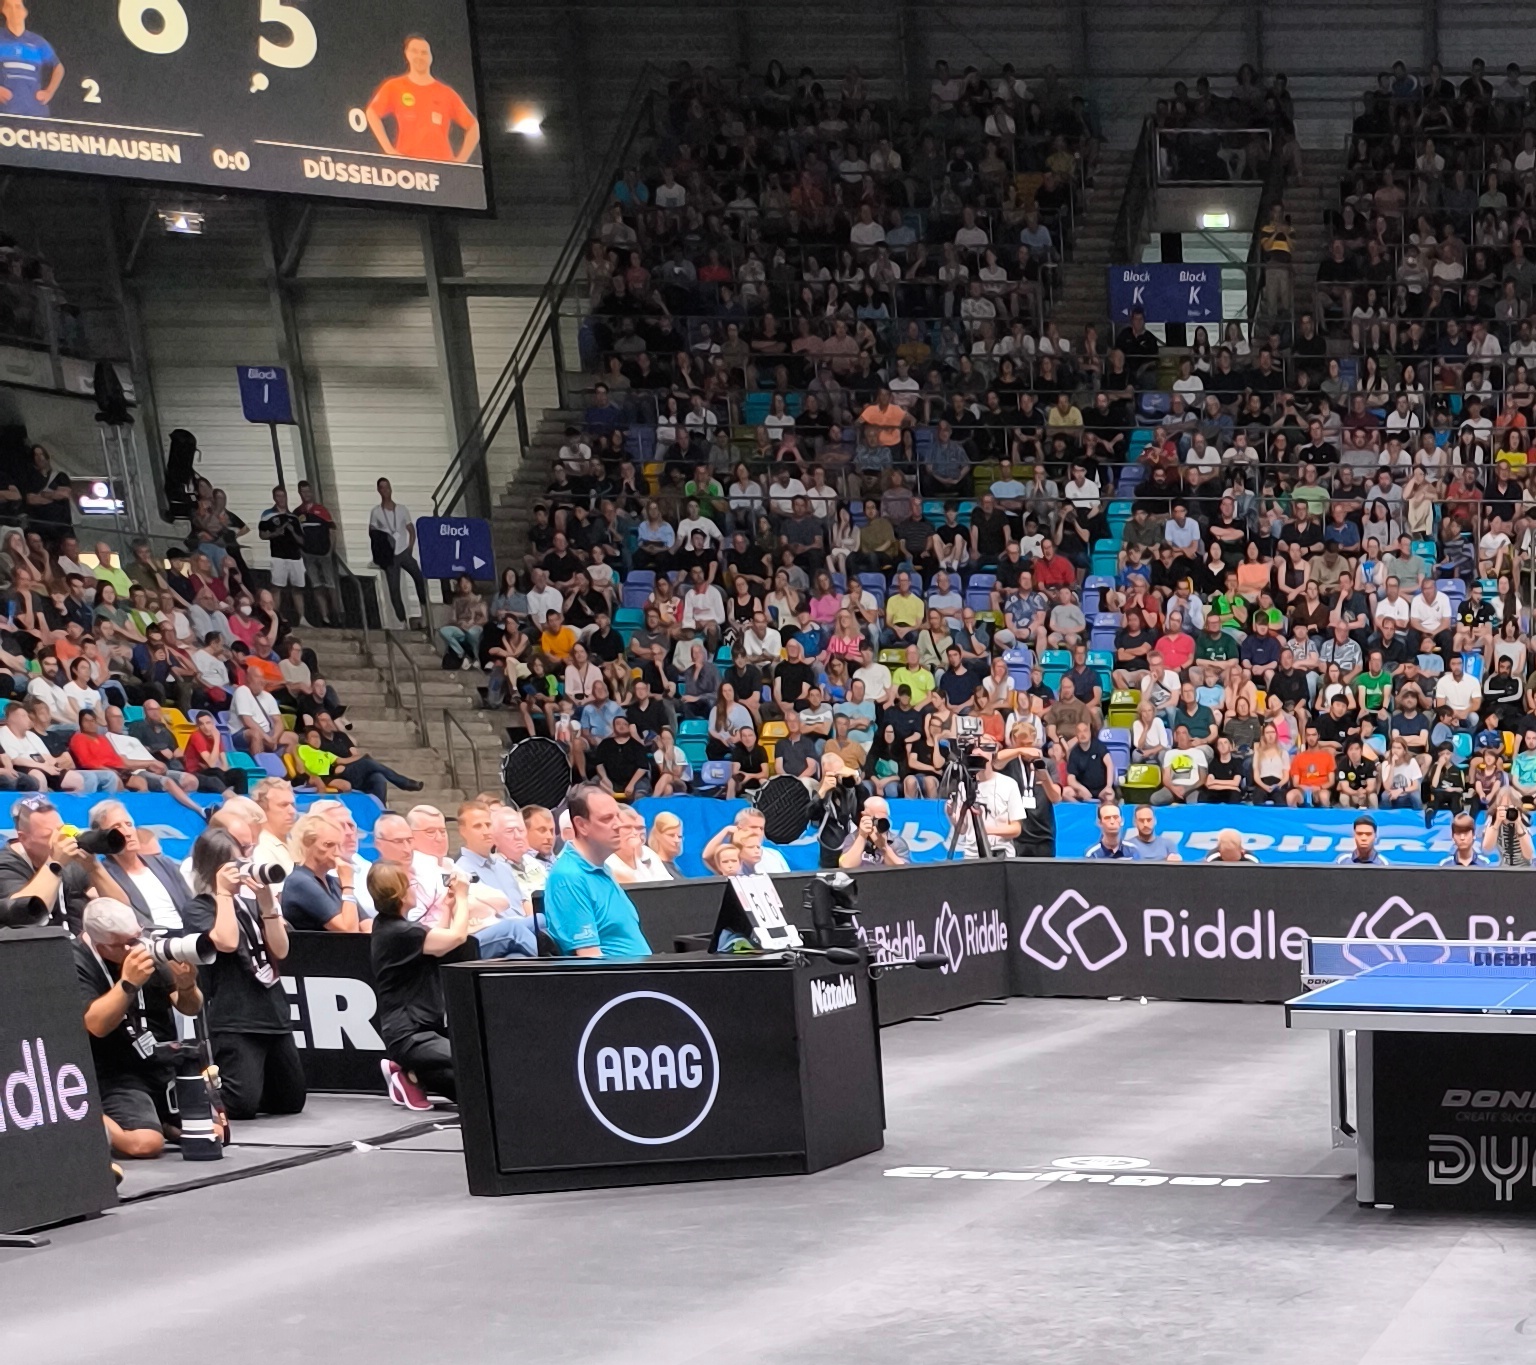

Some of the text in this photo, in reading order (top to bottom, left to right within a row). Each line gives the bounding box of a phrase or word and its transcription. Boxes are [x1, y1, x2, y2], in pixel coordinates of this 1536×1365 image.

[258, 0, 318, 69] 5
[81, 78, 102, 104] 2
[348, 108, 368, 133] 0
[0, 127, 182, 165] OCHSENHAUSEN
[212, 148, 251, 172] 0:0
[302, 157, 441, 192] DÜSSELDORF
[1123, 270, 1151, 282] Block
[1179, 270, 1207, 282] Block
[1132, 286, 1146, 305] K
[1188, 286, 1201, 305] K
[964, 908, 1008, 956] Riddle
[1143, 908, 1310, 961] Riddle
[596, 1043, 703, 1092] ARAG
[1455, 1111, 1497, 1123] CREATE
